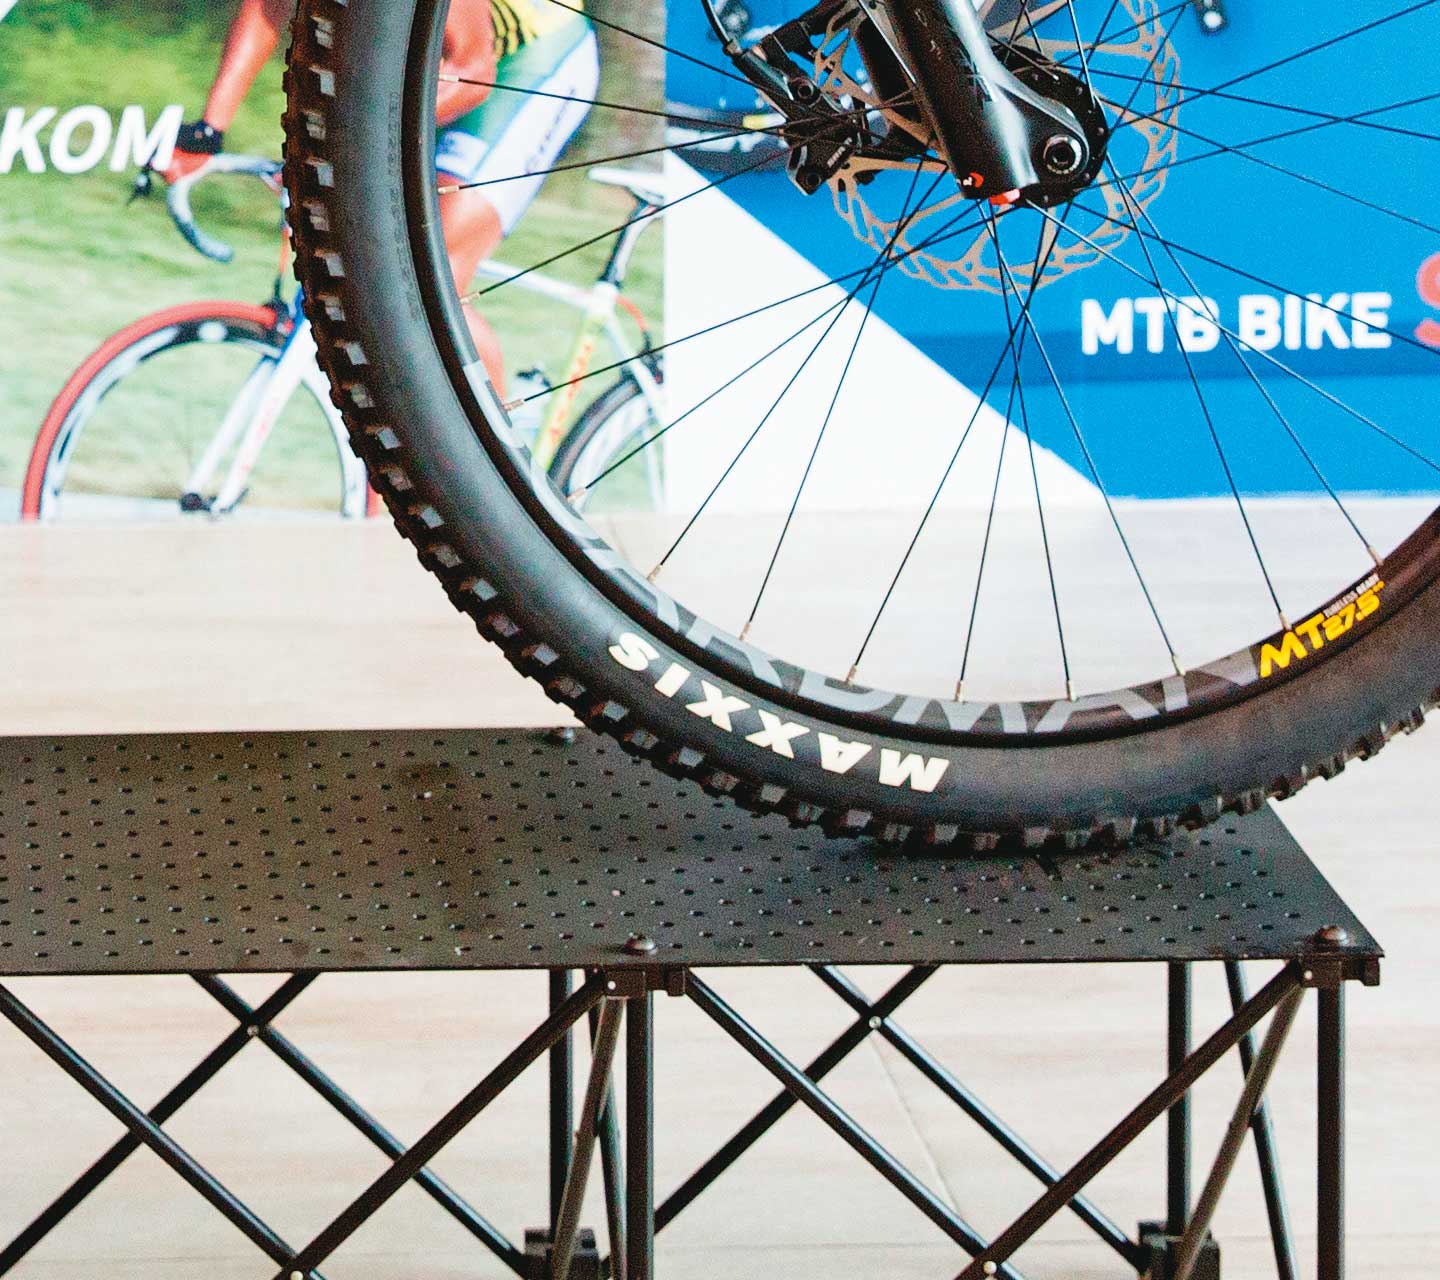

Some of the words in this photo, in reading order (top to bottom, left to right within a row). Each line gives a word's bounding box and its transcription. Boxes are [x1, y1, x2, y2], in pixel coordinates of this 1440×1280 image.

[1080, 295, 1220, 355] MTB
[1239, 289, 1393, 352] BIKE
[606, 630, 952, 794] MAXXIS
